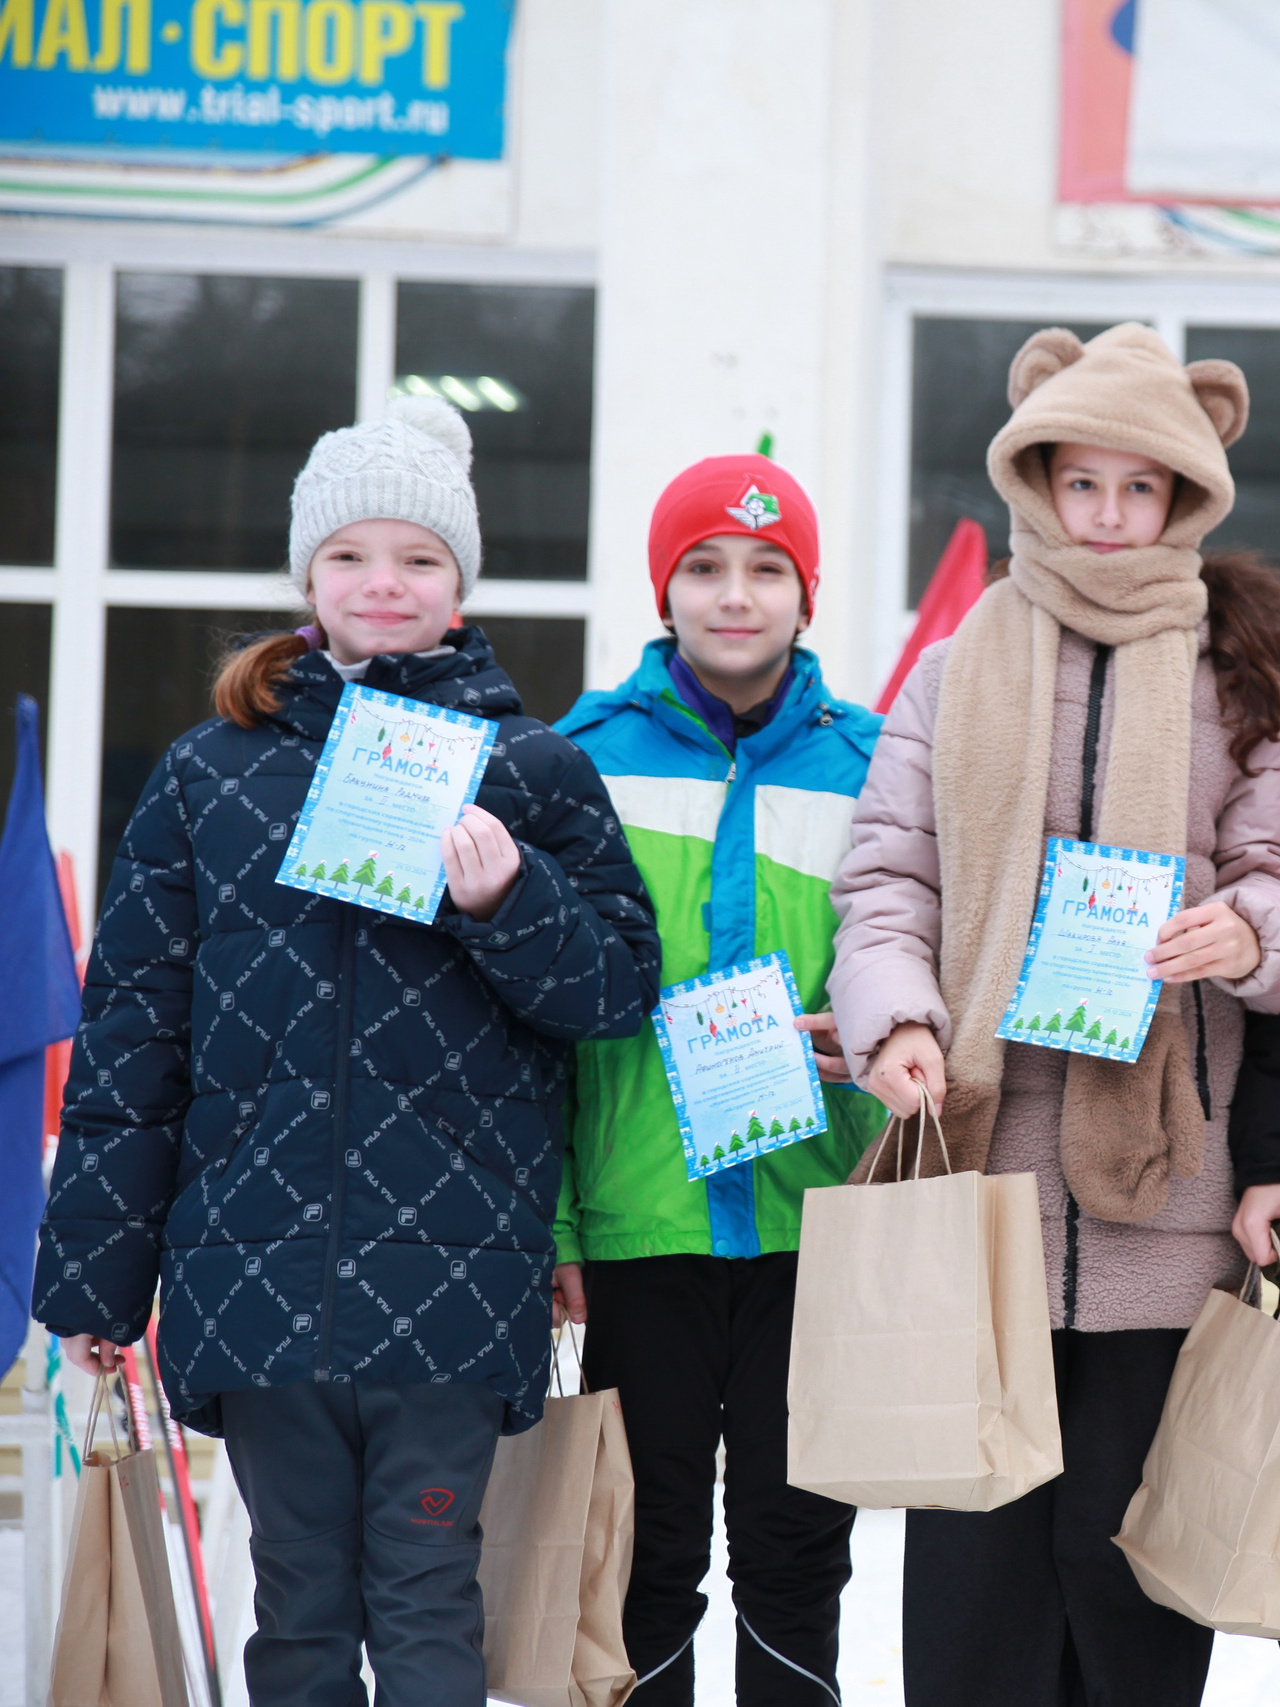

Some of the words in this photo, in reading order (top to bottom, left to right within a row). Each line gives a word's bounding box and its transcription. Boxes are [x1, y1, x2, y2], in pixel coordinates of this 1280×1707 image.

[93, 82, 449, 136] www.trial-sport.ru
[351, 746, 452, 786] ГРАМОТА
[251, 844, 267, 860] FILA
[237, 863, 252, 880] FILA
[143, 897, 155, 915] FILA
[239, 903, 254, 919] FILA
[1061, 899, 1152, 927] ГРАМОТА
[251, 951, 266, 968] FILA
[370, 948, 385, 965] FILA
[236, 971, 251, 987] FILA
[297, 1001, 313, 1017] FILA
[382, 1006, 400, 1021] FILA
[238, 1011, 252, 1027] FILA
[255, 1025, 271, 1041] FILA
[364, 1022, 382, 1037] FILA
[687, 1012, 779, 1054] ГРАМОТА
[363, 1059, 377, 1077] FILA
[111, 1090, 124, 1107] FILA
[126, 1108, 142, 1123] FILA
[290, 1111, 307, 1127] FILA
[380, 1113, 397, 1129] FILA
[103, 1137, 121, 1152] FILA
[274, 1129, 289, 1145] FILA
[363, 1131, 381, 1147] FILA
[98, 1175, 112, 1193] FILA
[271, 1168, 284, 1186] FILA
[363, 1169, 379, 1187] FILA
[435, 1172, 450, 1188] FILA
[469, 1174, 481, 1191] FILA
[113, 1193, 128, 1211] FILA
[286, 1185, 302, 1203] FILA
[381, 1187, 397, 1204] FILA
[420, 1190, 436, 1205] FILA
[87, 1246, 105, 1261] FILA
[82, 1283, 96, 1301] FILA
[261, 1278, 275, 1295] FILA
[358, 1280, 375, 1297] FILA
[432, 1281, 448, 1297] FILA
[468, 1282, 481, 1300] FILA
[276, 1294, 291, 1312] FILA
[377, 1297, 392, 1314] FILA
[416, 1299, 432, 1315] FILA
[482, 1300, 495, 1318] FILA
[219, 1339, 231, 1356] FILA
[276, 1336, 292, 1353] FILA
[372, 1338, 390, 1355] FILA
[477, 1341, 494, 1357] FILA
[354, 1357, 372, 1371] FILA
[458, 1358, 476, 1372] FILA
